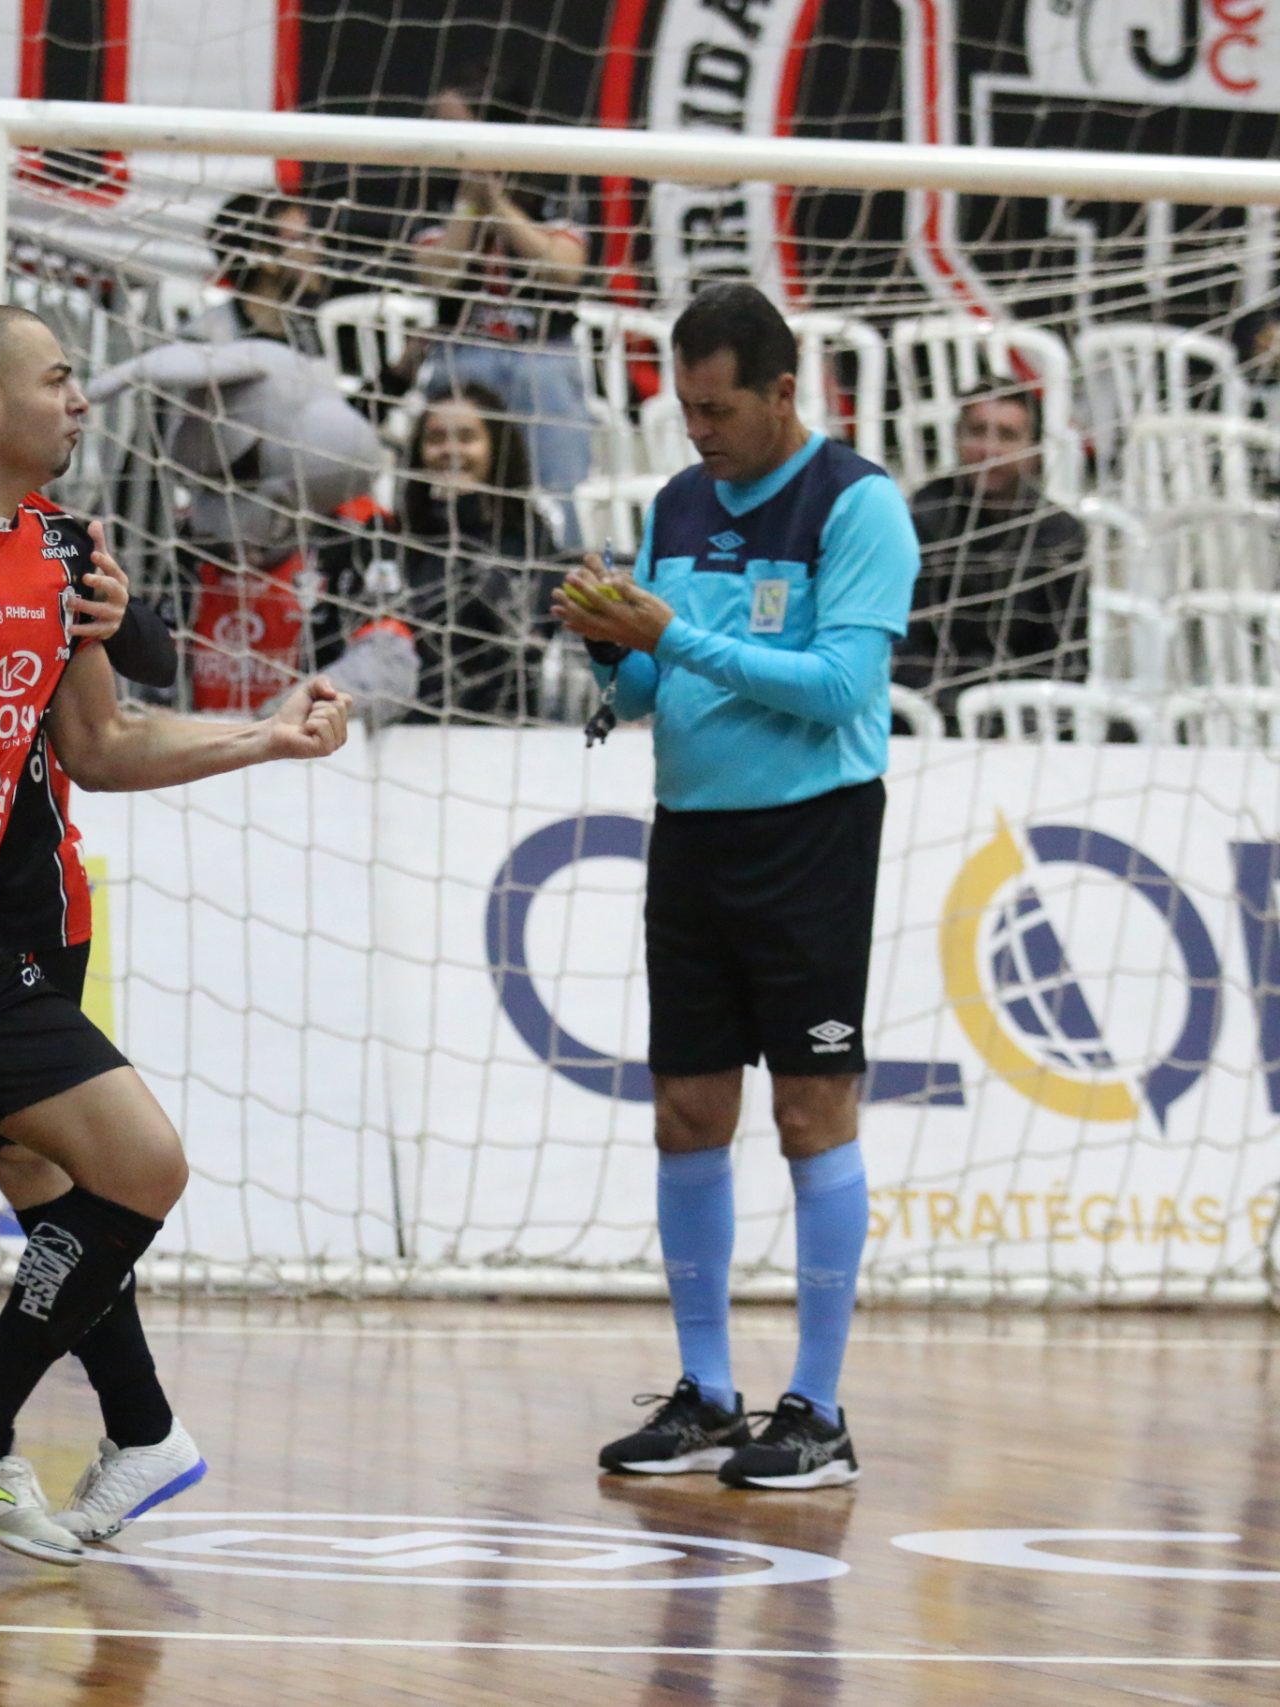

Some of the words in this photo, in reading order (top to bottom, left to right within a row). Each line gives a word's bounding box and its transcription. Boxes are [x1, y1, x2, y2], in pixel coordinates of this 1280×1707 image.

[40, 544, 79, 560] KRONA
[5, 605, 47, 621] RHBrasil
[867, 1178, 1227, 1246] STRATÉGIAS
